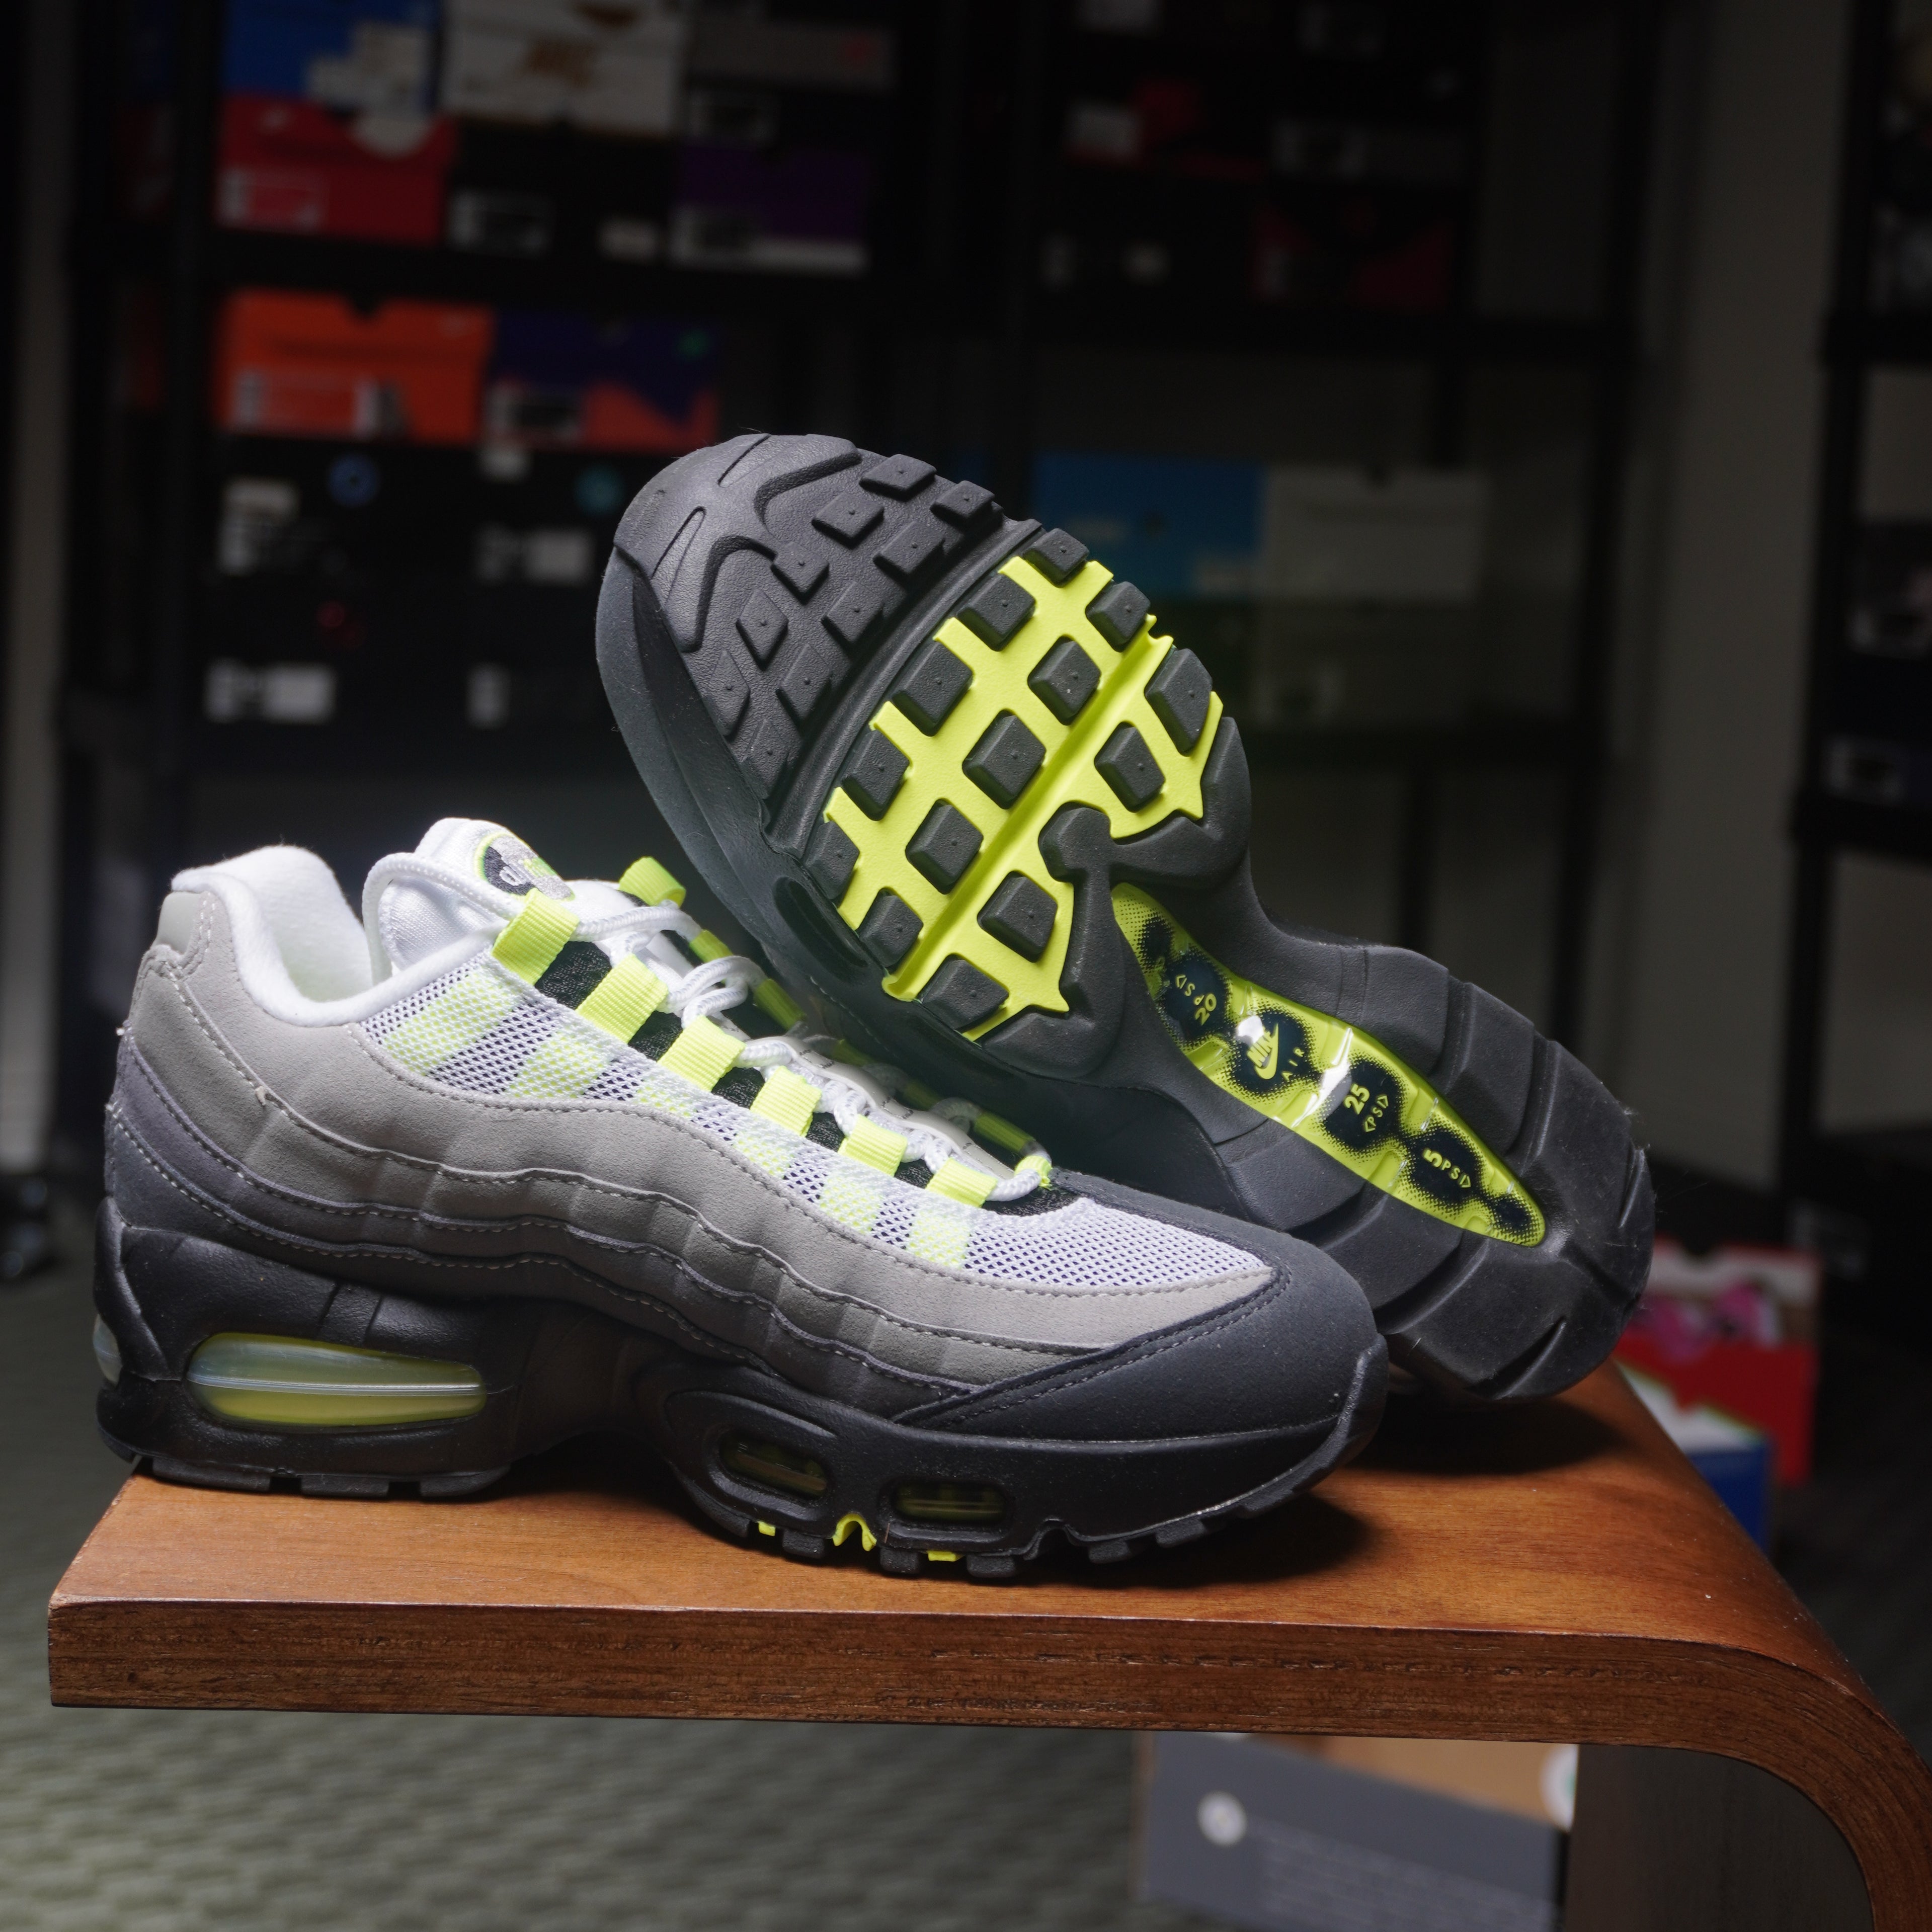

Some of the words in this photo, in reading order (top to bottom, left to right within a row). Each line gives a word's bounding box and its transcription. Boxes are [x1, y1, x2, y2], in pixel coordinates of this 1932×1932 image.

[1195, 993, 1217, 1026] 20
[1247, 1026, 1272, 1068] NIKE
[1282, 1048, 1305, 1081] AIR
[1344, 1083, 1370, 1115] 25
